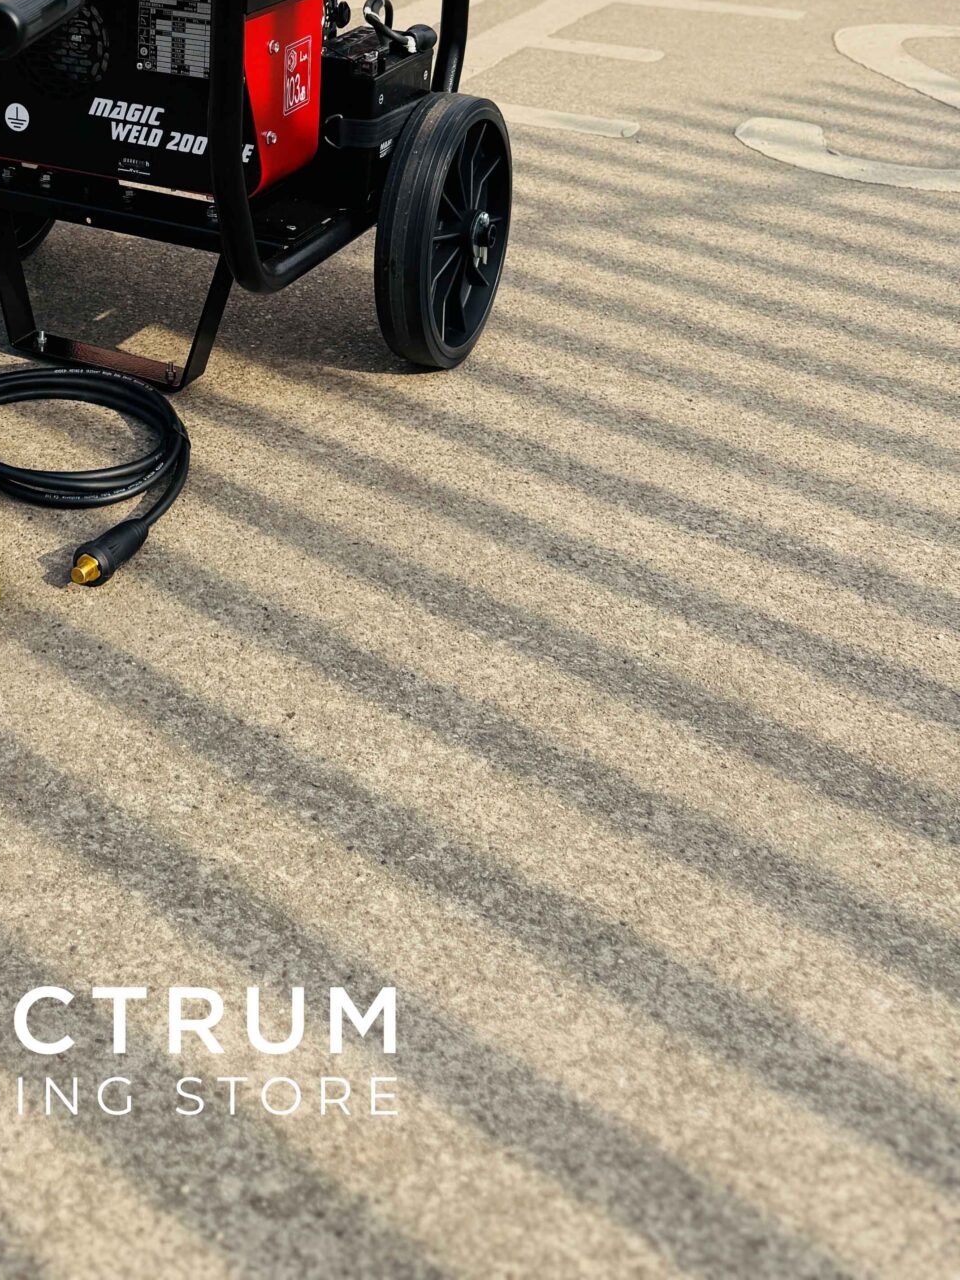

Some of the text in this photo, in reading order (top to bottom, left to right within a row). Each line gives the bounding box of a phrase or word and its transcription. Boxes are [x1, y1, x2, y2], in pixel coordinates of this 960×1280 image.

[88, 97, 165, 126] MAGIC
[111, 121, 164, 148] WELD
[165, 131, 208, 156] 200
